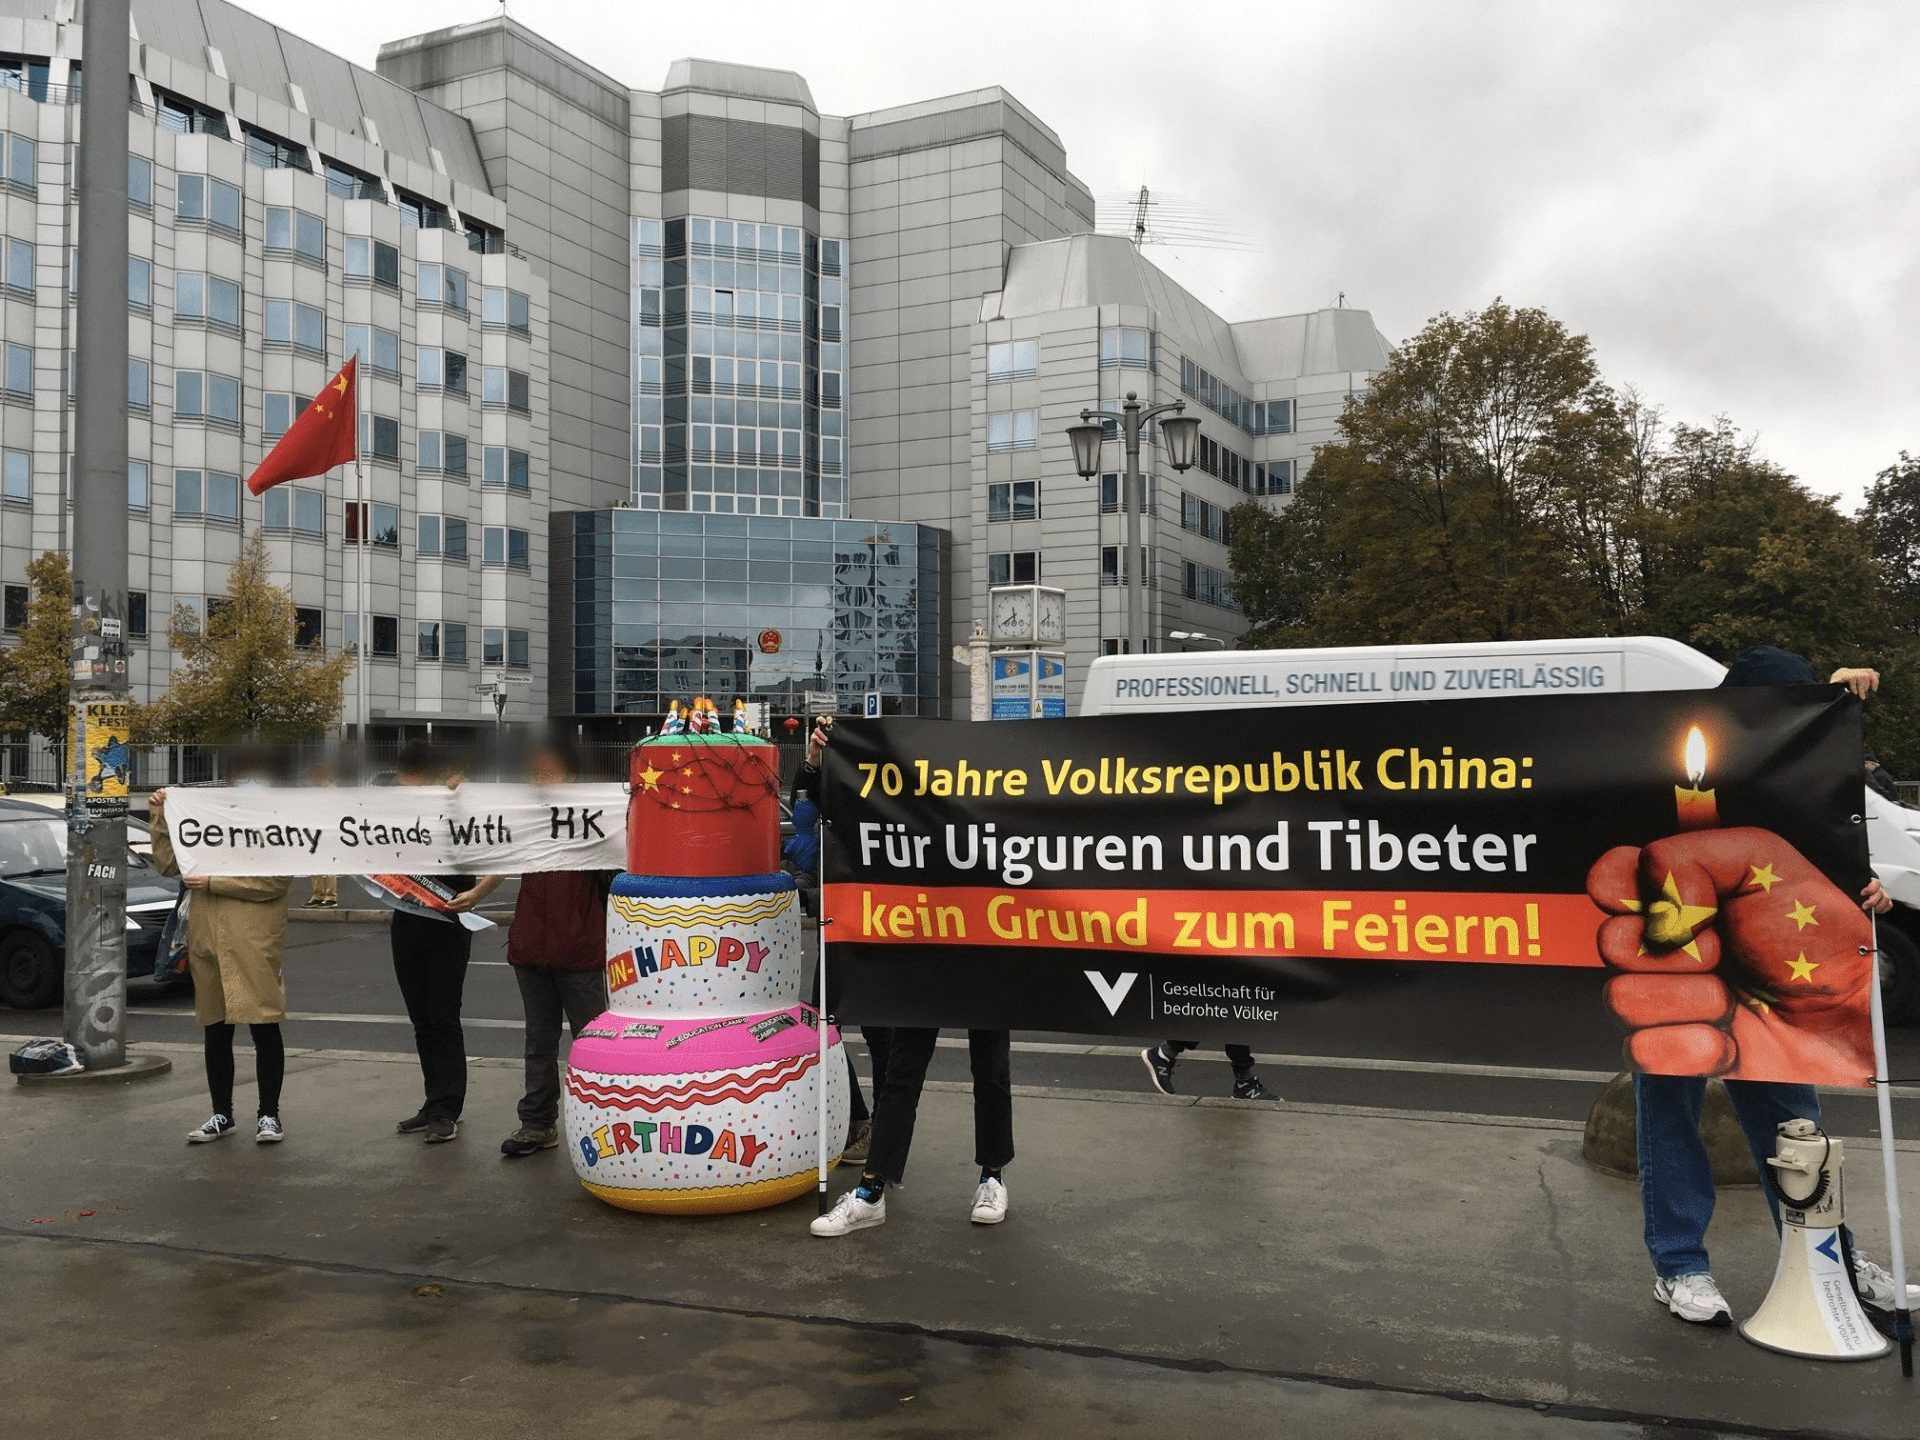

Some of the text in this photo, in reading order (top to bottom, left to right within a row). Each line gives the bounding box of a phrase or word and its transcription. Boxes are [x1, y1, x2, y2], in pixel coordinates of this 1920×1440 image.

[1116, 663, 1605, 698] PROFESSIONELL, SCHNELL UND ZUVERLÄSSIG
[858, 746, 1533, 805] 70 Jahre Volksrepublik China:
[178, 806, 606, 854] Germany Stands With HK
[859, 819, 1537, 886] Für Uiguren und Tibeter
[87, 863, 116, 879] FACH
[861, 890, 1541, 956] kein Grund zum Feiern!
[634, 935, 771, 978] HAPPY
[1163, 981, 1276, 1001] Gesellschaft für
[1163, 1000, 1279, 1021] bedrohte Völker
[580, 1121, 768, 1168] BIRTHDAY
